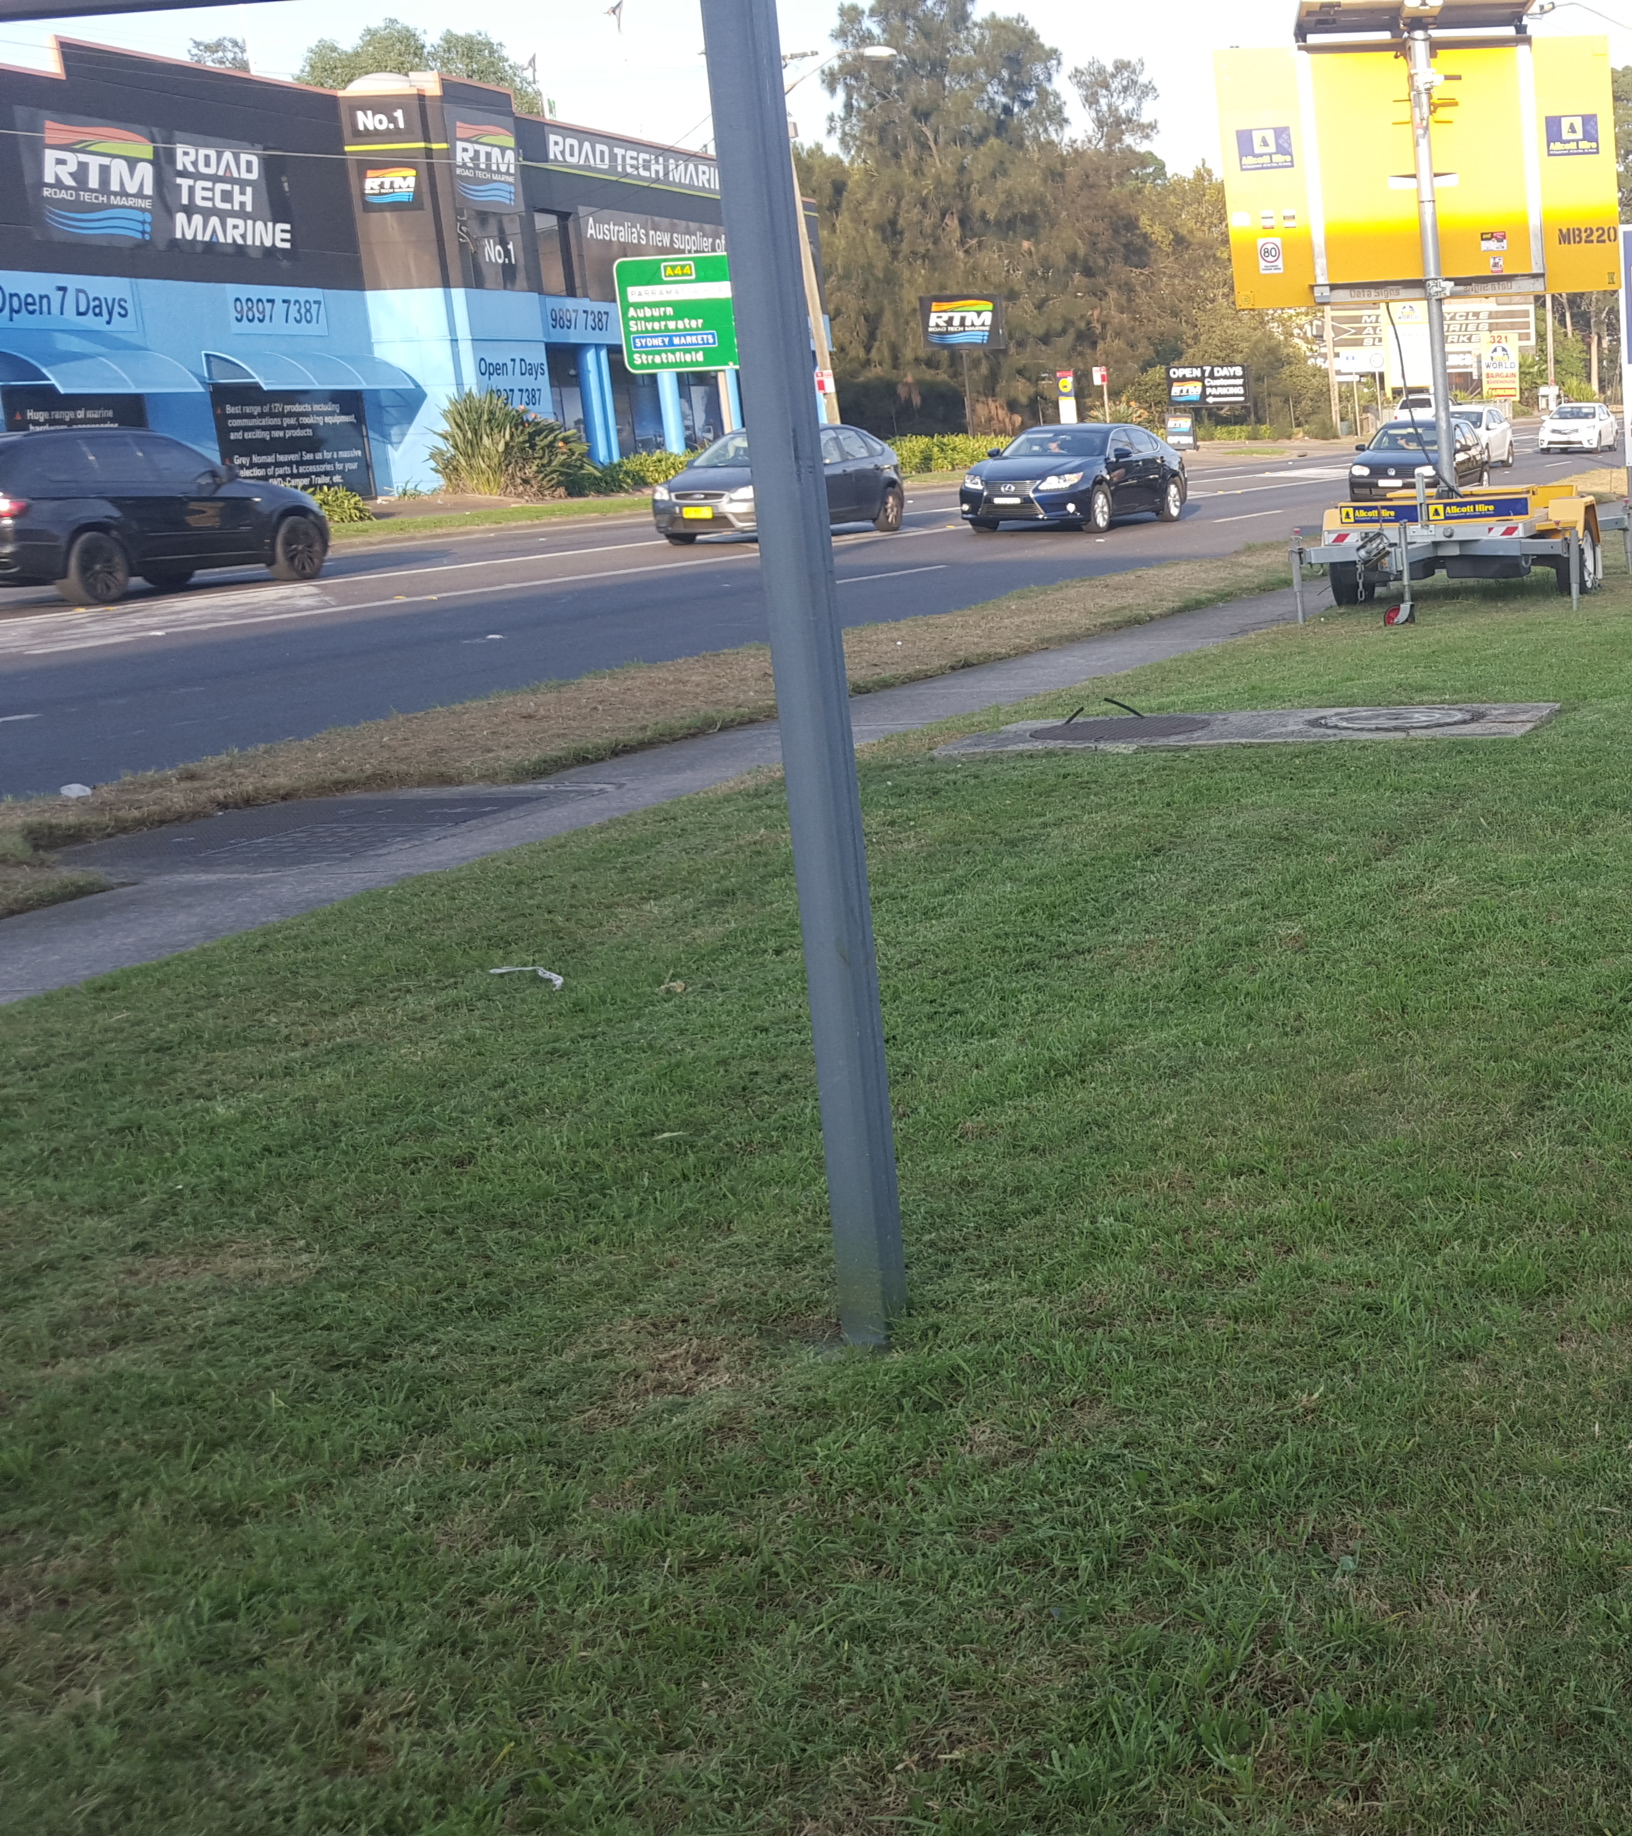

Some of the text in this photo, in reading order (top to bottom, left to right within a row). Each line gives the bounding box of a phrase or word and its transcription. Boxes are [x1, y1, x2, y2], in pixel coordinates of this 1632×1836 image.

[356, 109, 405, 131] No.1
[176, 143, 259, 180] ROAD
[456, 141, 515, 174] RTM
[549, 134, 610, 169] ROAD
[613, 147, 664, 180] TECH
[44, 148, 153, 195] RTM
[456, 168, 515, 183] ROAD TECH MARINE
[365, 176, 415, 190] RTM
[43, 187, 153, 209] ROAD TECH MARINE
[176, 177, 252, 212] TECH
[175, 212, 291, 249] MARINE
[587, 216, 726, 254] Australia's new supplier of
[1558, 226, 1617, 245] MB220
[485, 238, 516, 265] No.1
[1263, 247, 1277, 258] 80
[666, 264, 692, 276] A44
[55, 286, 68, 316] 7
[75, 288, 128, 325] Days
[234, 297, 322, 325] 9897 7387
[628, 306, 674, 318] Auburn
[550, 308, 610, 332] 9897 7387
[629, 318, 704, 331] Silverwater
[929, 311, 992, 327] RTM
[635, 334, 714, 347] SYDNEY MARKETS
[1490, 335, 1508, 344] 321
[633, 351, 704, 364] Strathfield
[478, 357, 545, 380] Open 7 Days
[1169, 366, 1243, 378] OPEN 7 DAYS
[518, 388, 542, 406] 7387
[1206, 386, 1244, 395] PARKING
[27, 408, 113, 422] Huge range of marine
[226, 402, 340, 415] Best range of 12V products including
[228, 416, 281, 427] communications
[299, 414, 323, 425] cooking
[230, 428, 313, 440] and exciting new products
[234, 454, 250, 466] Grey
[252, 452, 275, 464] Nomad
[302, 451, 313, 460] See
[315, 451, 322, 459] us
[324, 450, 332, 459] for
[338, 449, 362, 458] massive
[239, 468, 266, 477] election
[267, 466, 274, 476] of
[275, 465, 291, 477] parts
[299, 462, 334, 473] accessories
[335, 461, 343, 471] for
[345, 461, 358, 472] your
[1445, 504, 1474, 514] Allcott
[1475, 503, 1495, 513] Hire
